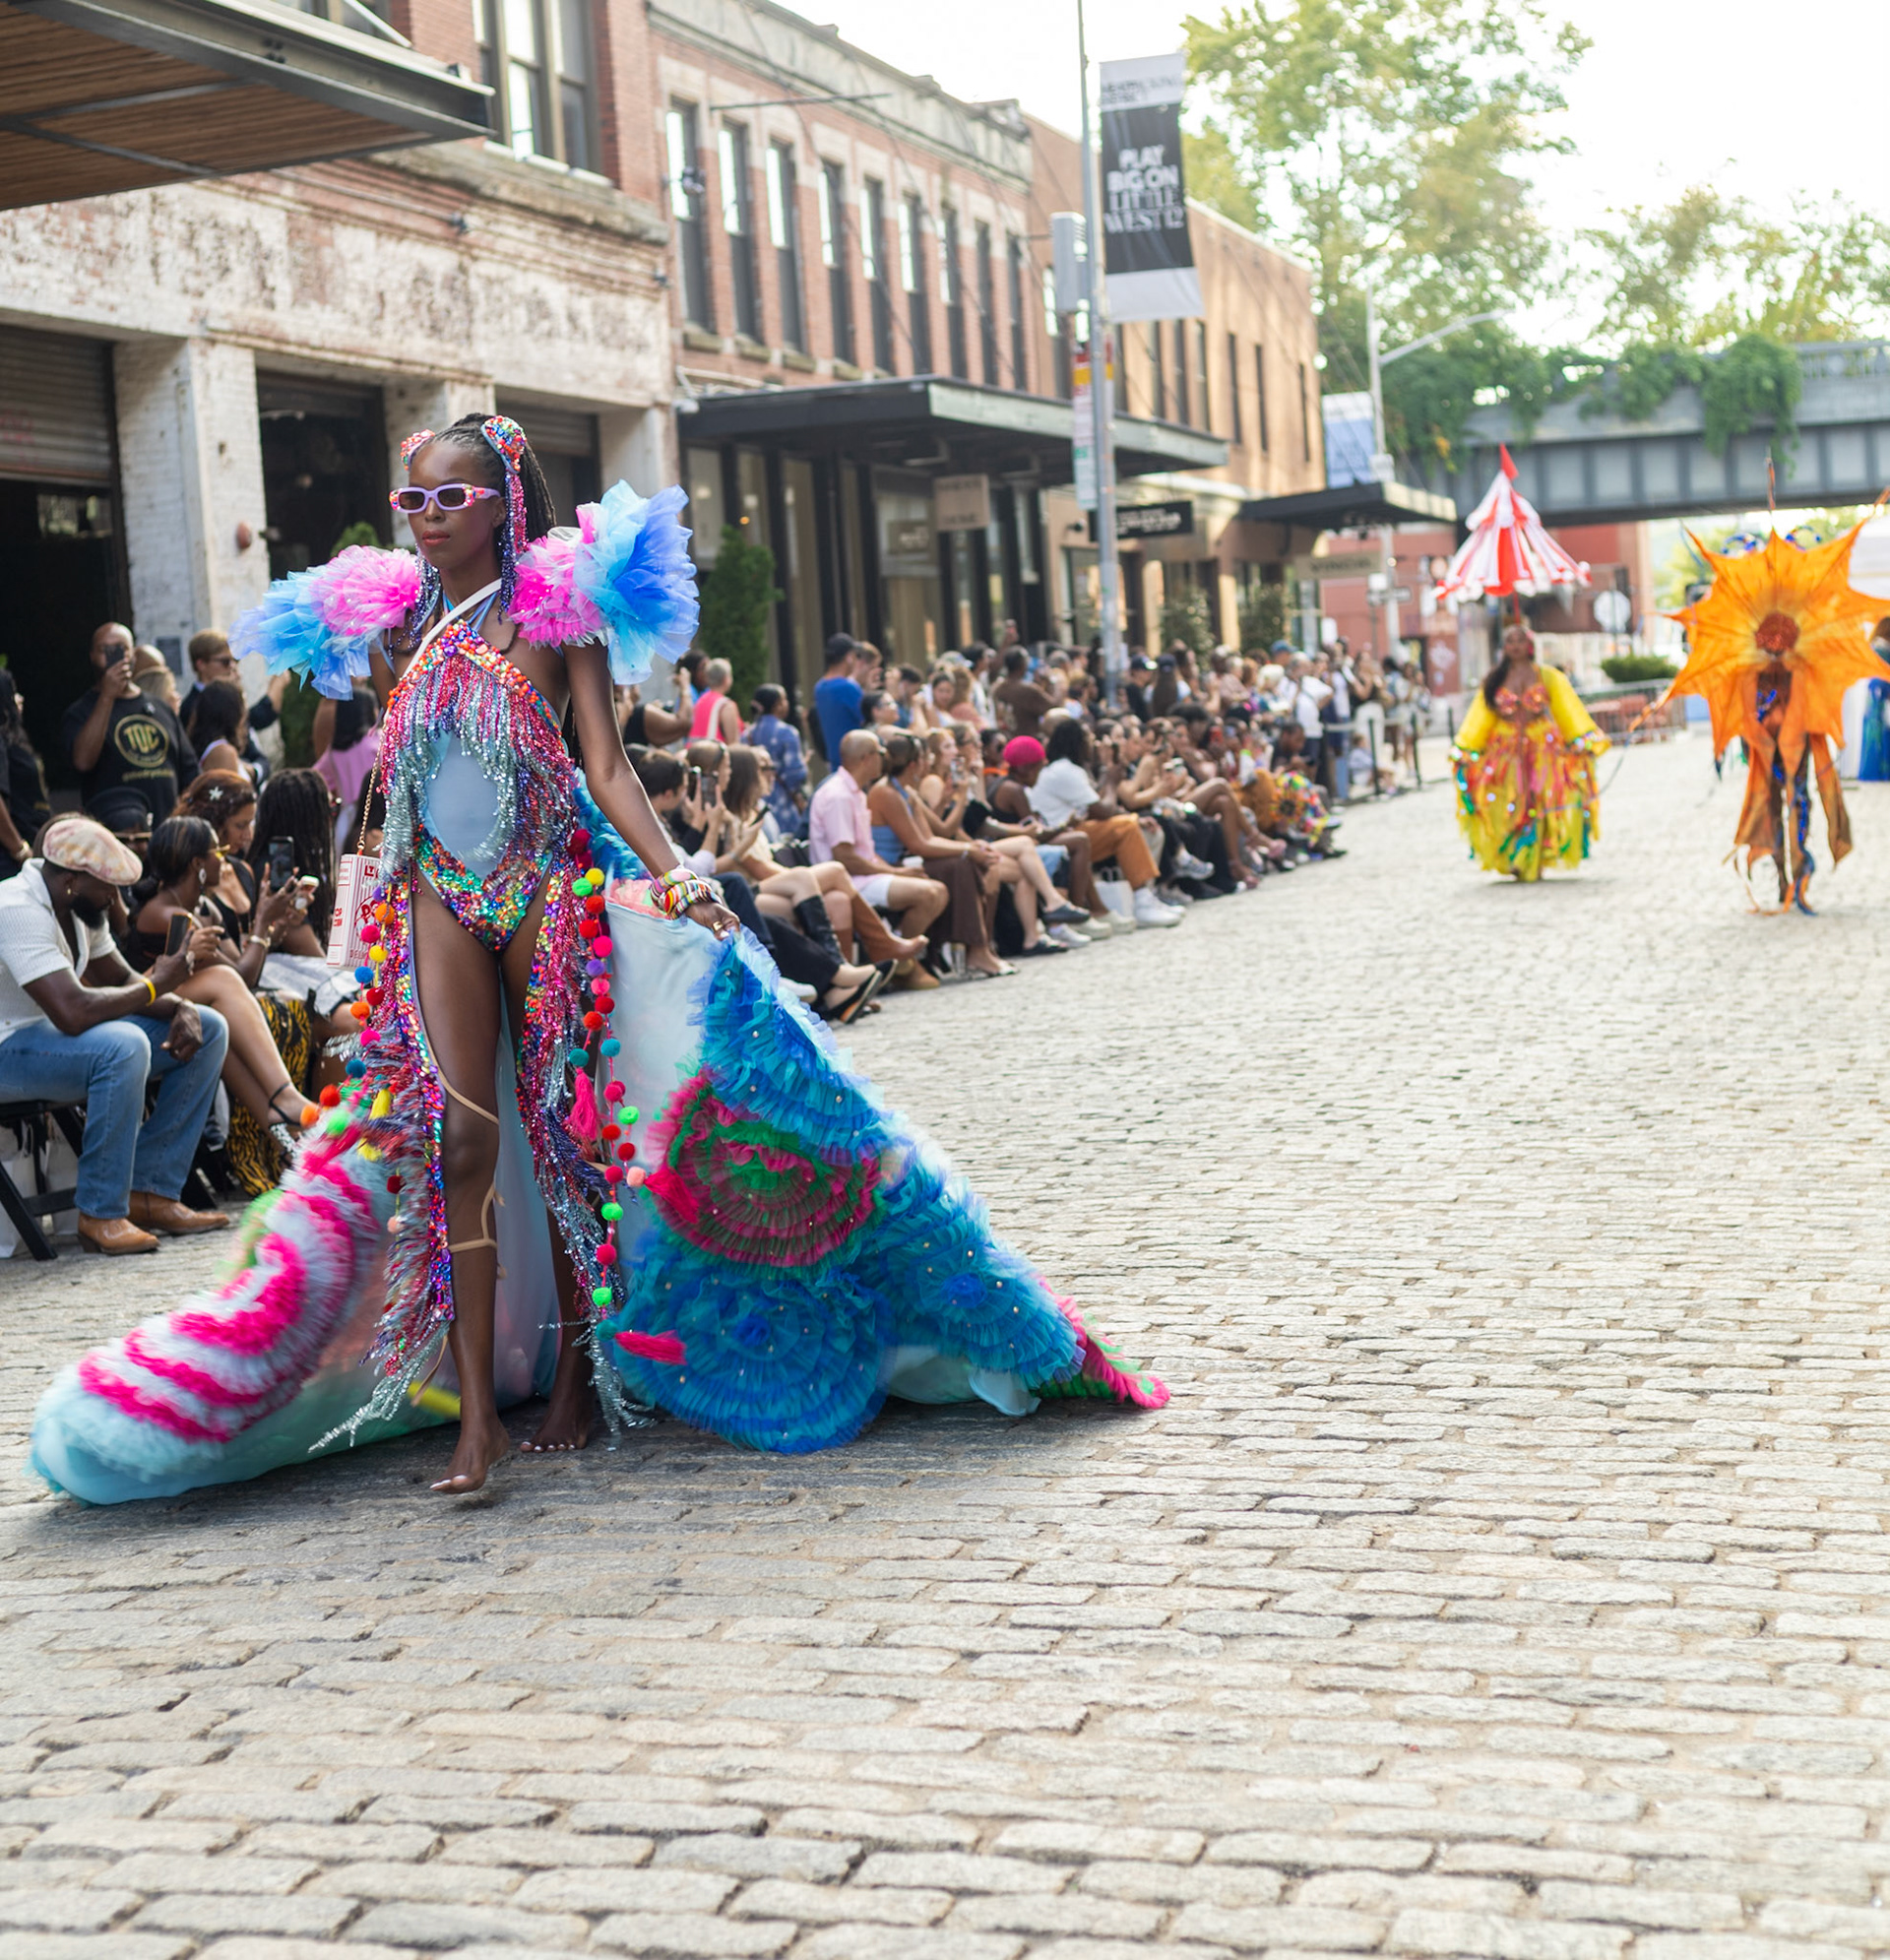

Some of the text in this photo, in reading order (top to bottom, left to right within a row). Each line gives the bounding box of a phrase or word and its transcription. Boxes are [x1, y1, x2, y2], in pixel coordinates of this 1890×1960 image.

[1119, 145, 1165, 169] PLAY
[1106, 164, 1179, 193] BIG ON
[1108, 186, 1180, 211] LITTLE
